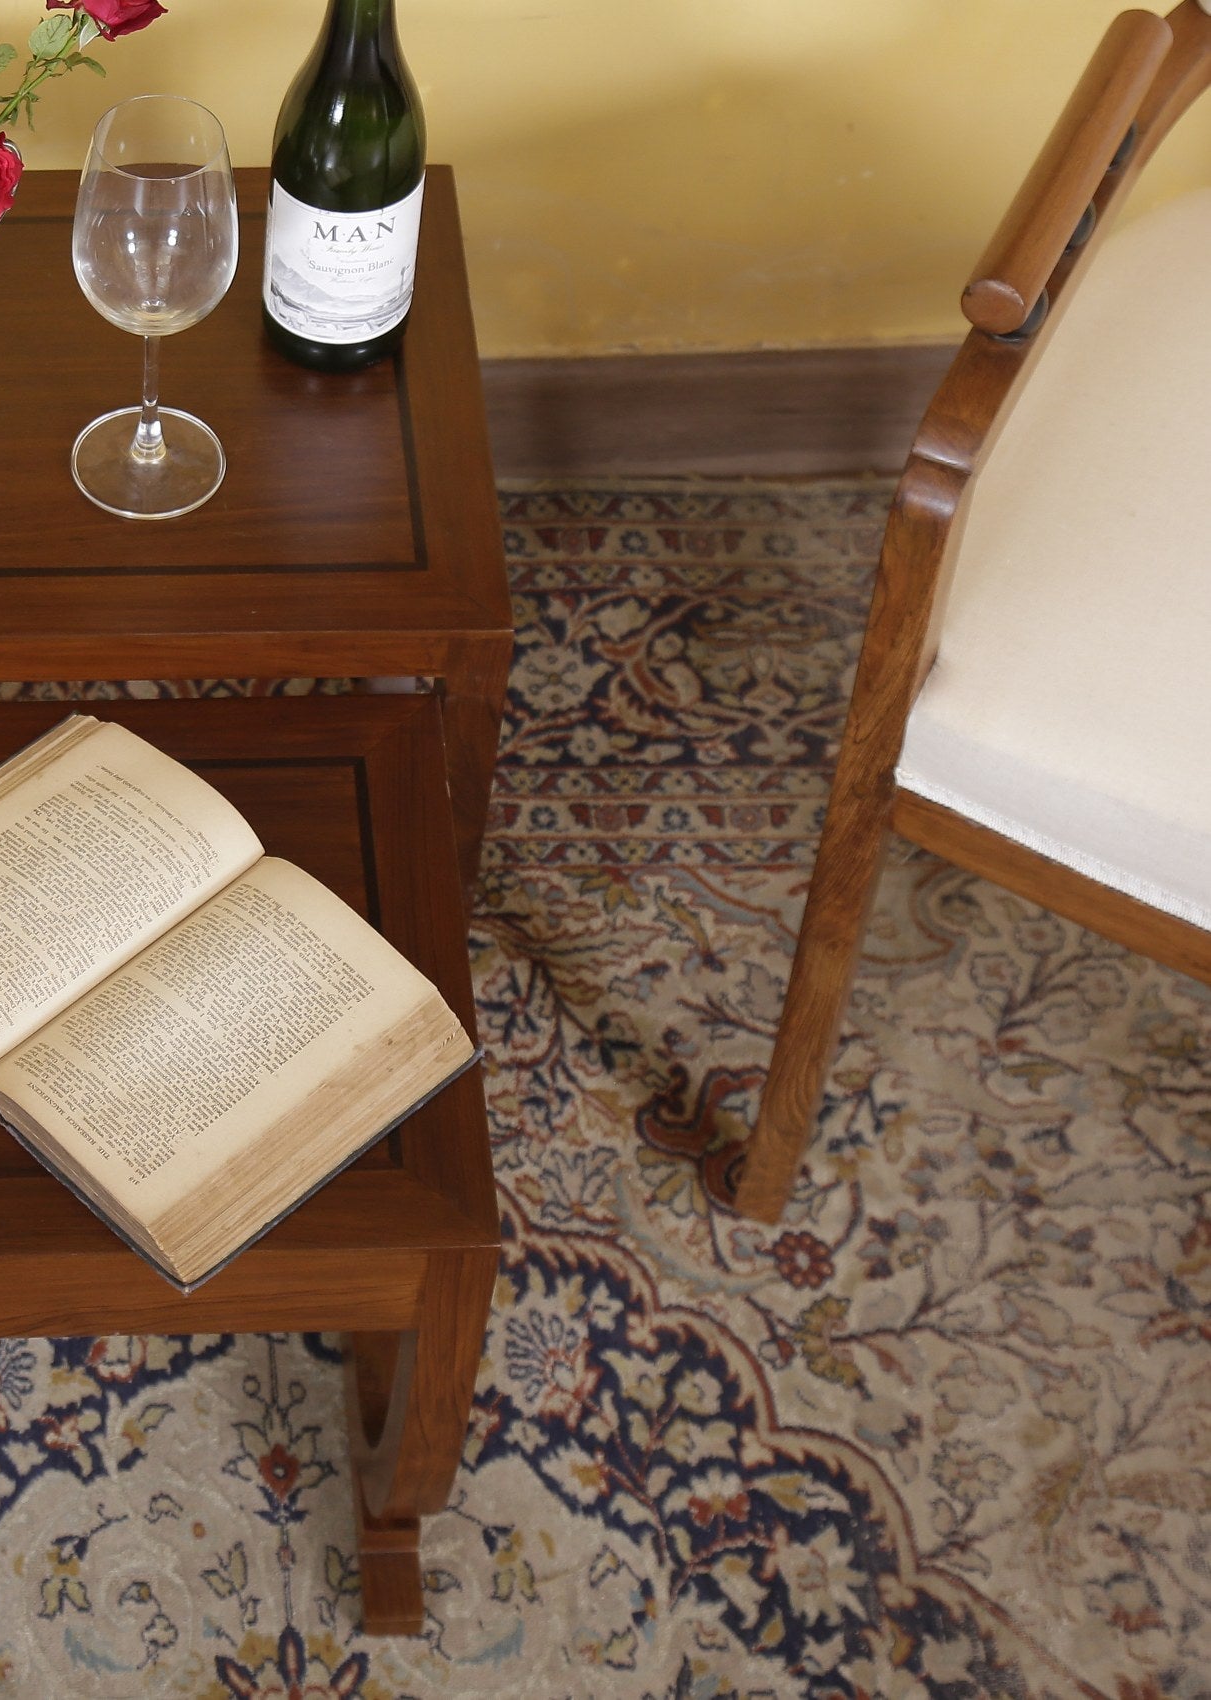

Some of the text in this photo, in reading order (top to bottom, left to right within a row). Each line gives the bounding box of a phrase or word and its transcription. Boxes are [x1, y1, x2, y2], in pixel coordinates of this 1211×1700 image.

[308, 260, 365, 277] Sauvignon
[368, 257, 395, 272] Blanc
[25, 1078, 111, 1160] THE RESEARCH MAGNIFICENT
